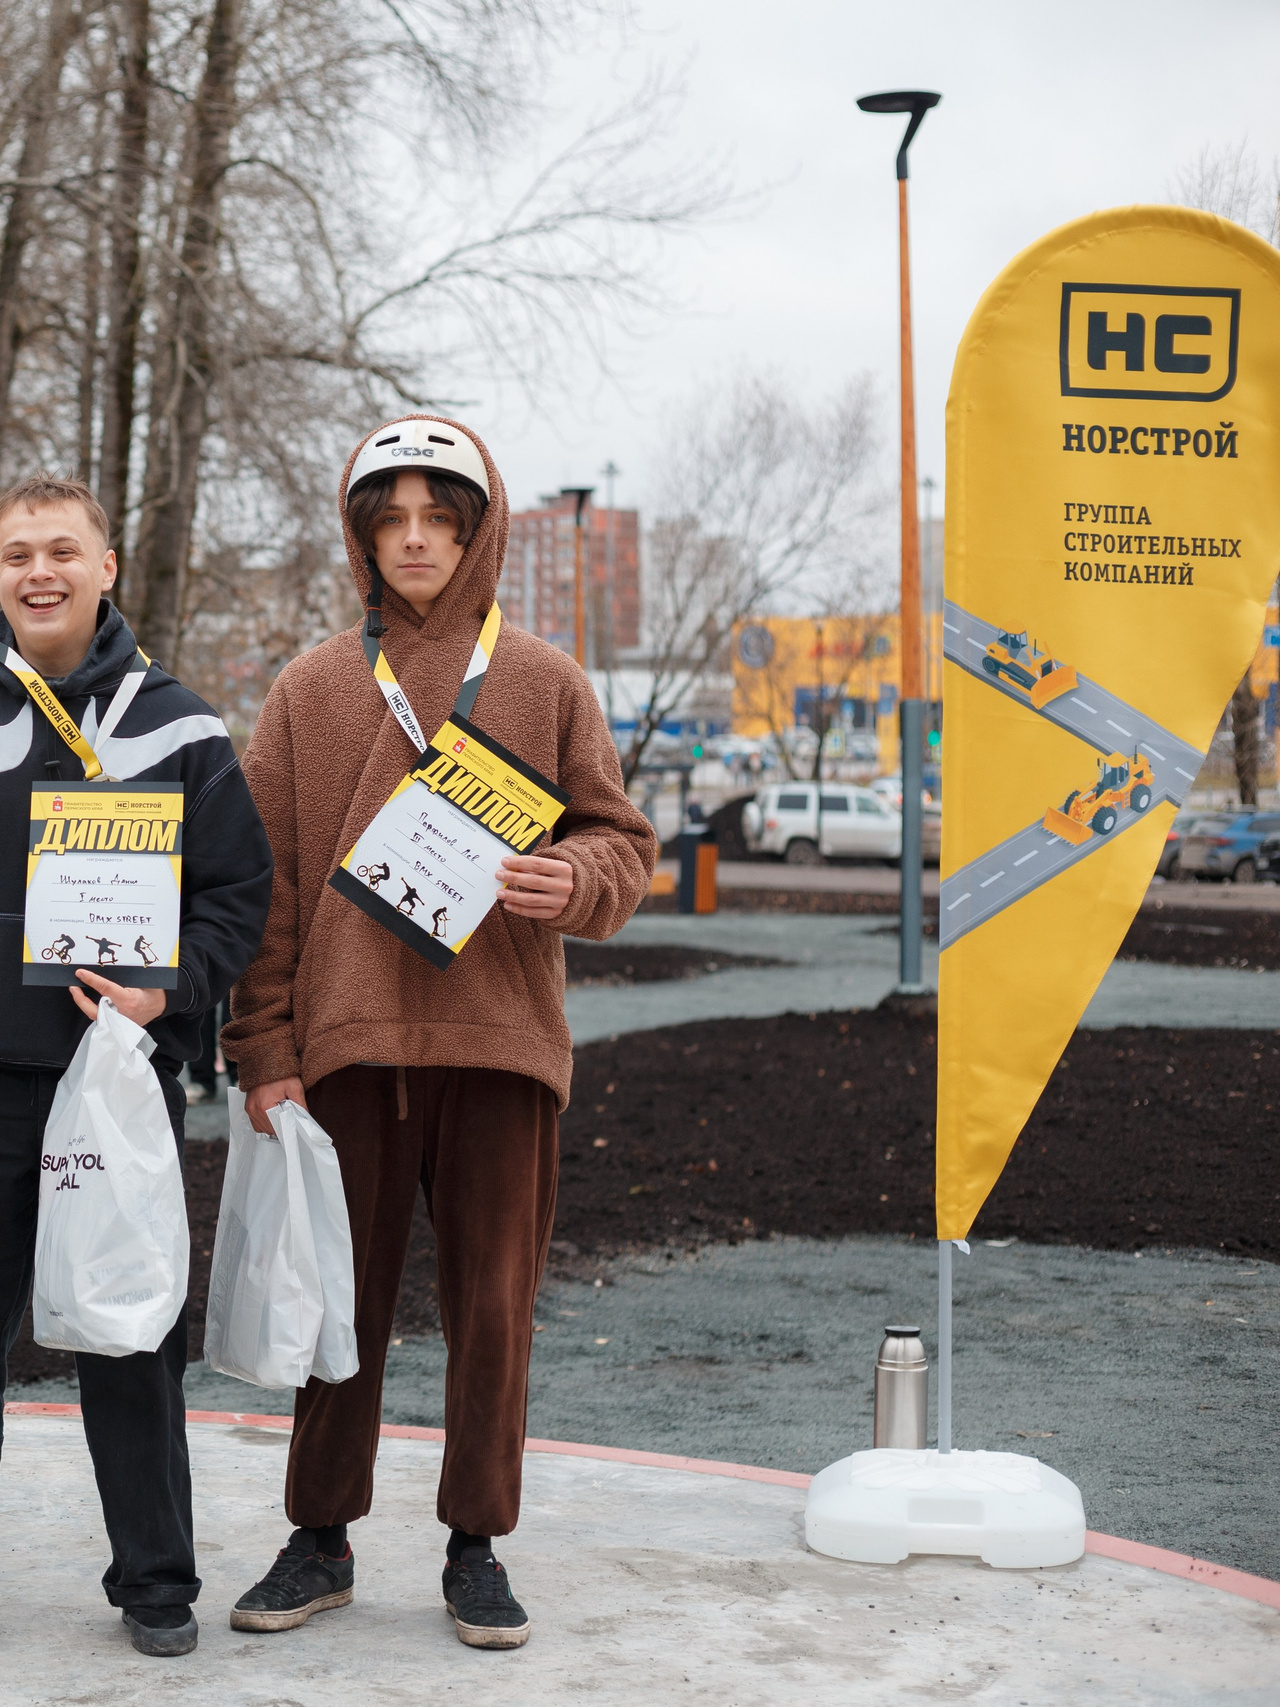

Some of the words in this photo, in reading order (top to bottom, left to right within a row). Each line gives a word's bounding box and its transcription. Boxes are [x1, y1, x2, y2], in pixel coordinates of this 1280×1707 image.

[1087, 311, 1212, 374] НС
[1064, 502, 1152, 525] ГРУППА
[1064, 531, 1242, 558] СТРОИТЕЛЬНЫХ
[1064, 561, 1194, 586] КОМПАНИЙ
[409, 752, 547, 852] ДИПЛОМ
[32, 818, 179, 855] ДИПЛОМ
[412, 860, 433, 878] BMX
[435, 879, 465, 902] STREET
[117, 915, 152, 924] STREET
